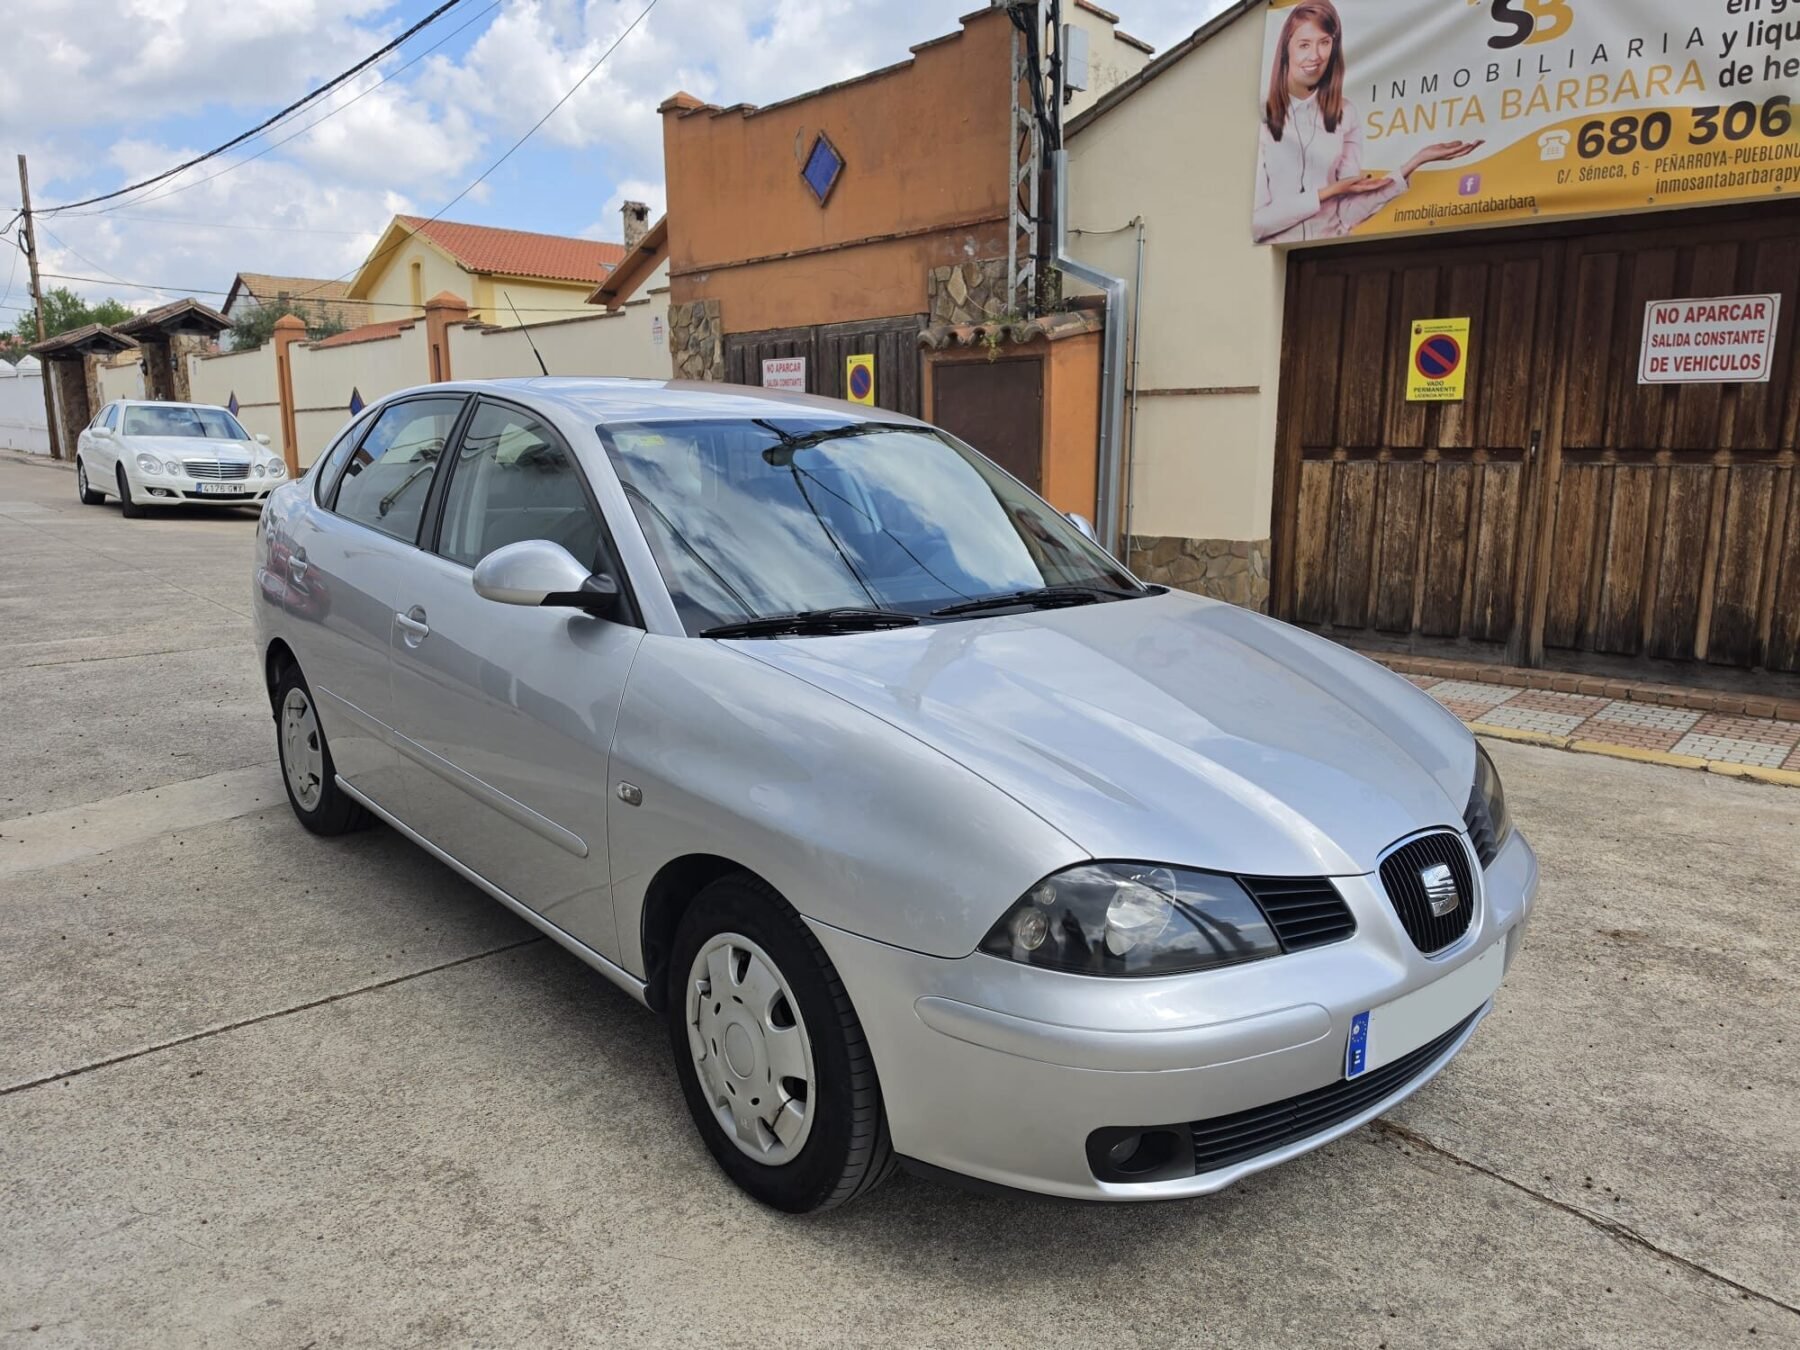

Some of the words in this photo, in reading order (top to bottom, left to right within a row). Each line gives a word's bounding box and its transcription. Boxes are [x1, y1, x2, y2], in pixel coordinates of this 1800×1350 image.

[1771, 0, 1800, 14] g
[1718, 30, 1738, 58] y
[1371, 27, 1705, 102] INMOBILIARIA
[1718, 60, 1754, 88] de
[1763, 54, 1800, 82] he
[1365, 95, 1486, 140] SANTA
[1500, 59, 1706, 121] BÁRBARA
[1576, 111, 1672, 159] 680
[1688, 95, 1792, 145] 306
[1578, 163, 1628, 182] Séneca,
[1632, 160, 1640, 176] 6
[1394, 195, 1536, 222] inmobiliariasantabarbara
[1655, 307, 1680, 325] NO
[1683, 302, 1766, 323] APARCAR
[1651, 332, 1691, 348] SALIDA
[1694, 329, 1766, 346] CONSTANTE
[1649, 356, 1669, 373] DE
[1673, 353, 1761, 373] VEHICULOS
